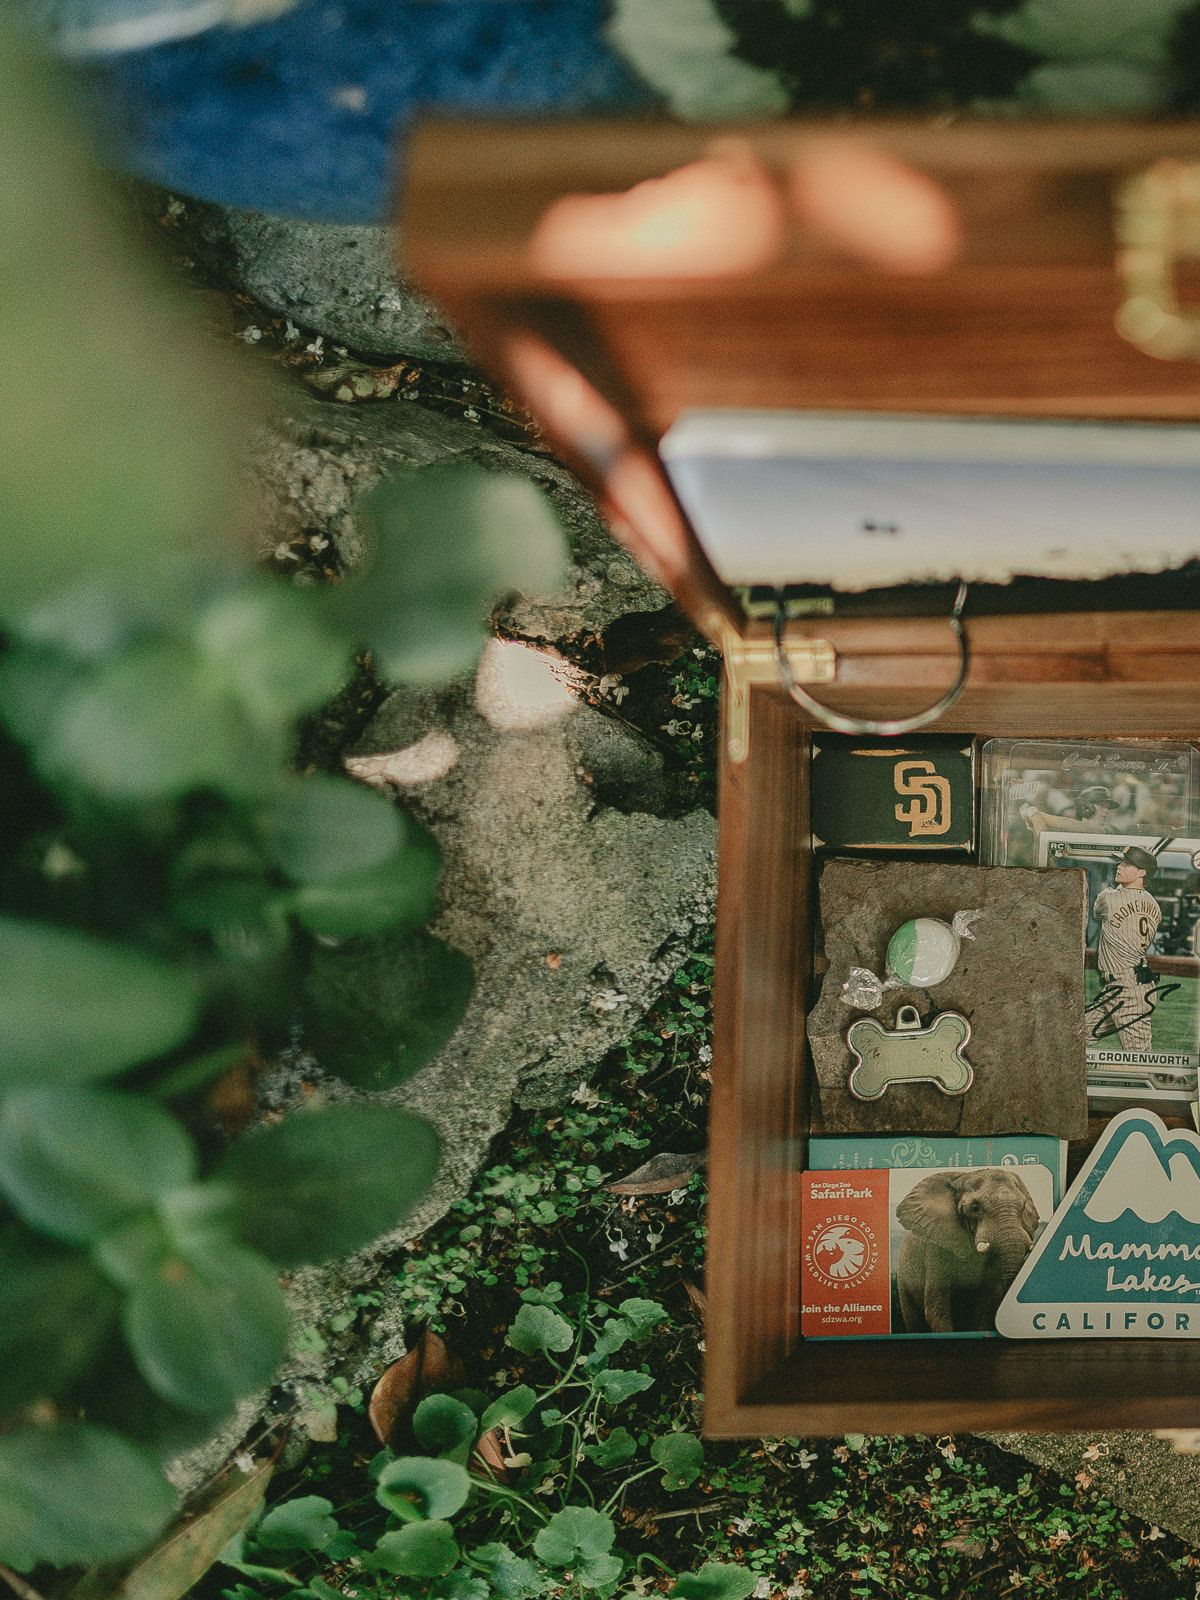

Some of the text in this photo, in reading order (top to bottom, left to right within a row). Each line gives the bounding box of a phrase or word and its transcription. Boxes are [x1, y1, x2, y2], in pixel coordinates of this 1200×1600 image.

[1050, 842, 1065, 850] RC
[1098, 1051, 1190, 1066] CRONENWORTH
[822, 1182, 839, 1190] Diego
[810, 1187, 873, 1199] Safari Park
[807, 1214, 875, 1241] SAN DIEGO ZOO
[805, 1251, 879, 1290] WILDLIFE ALLIANCE
[801, 1302, 883, 1314] Join the Alliance
[821, 1315, 863, 1324] sdzwa.org
